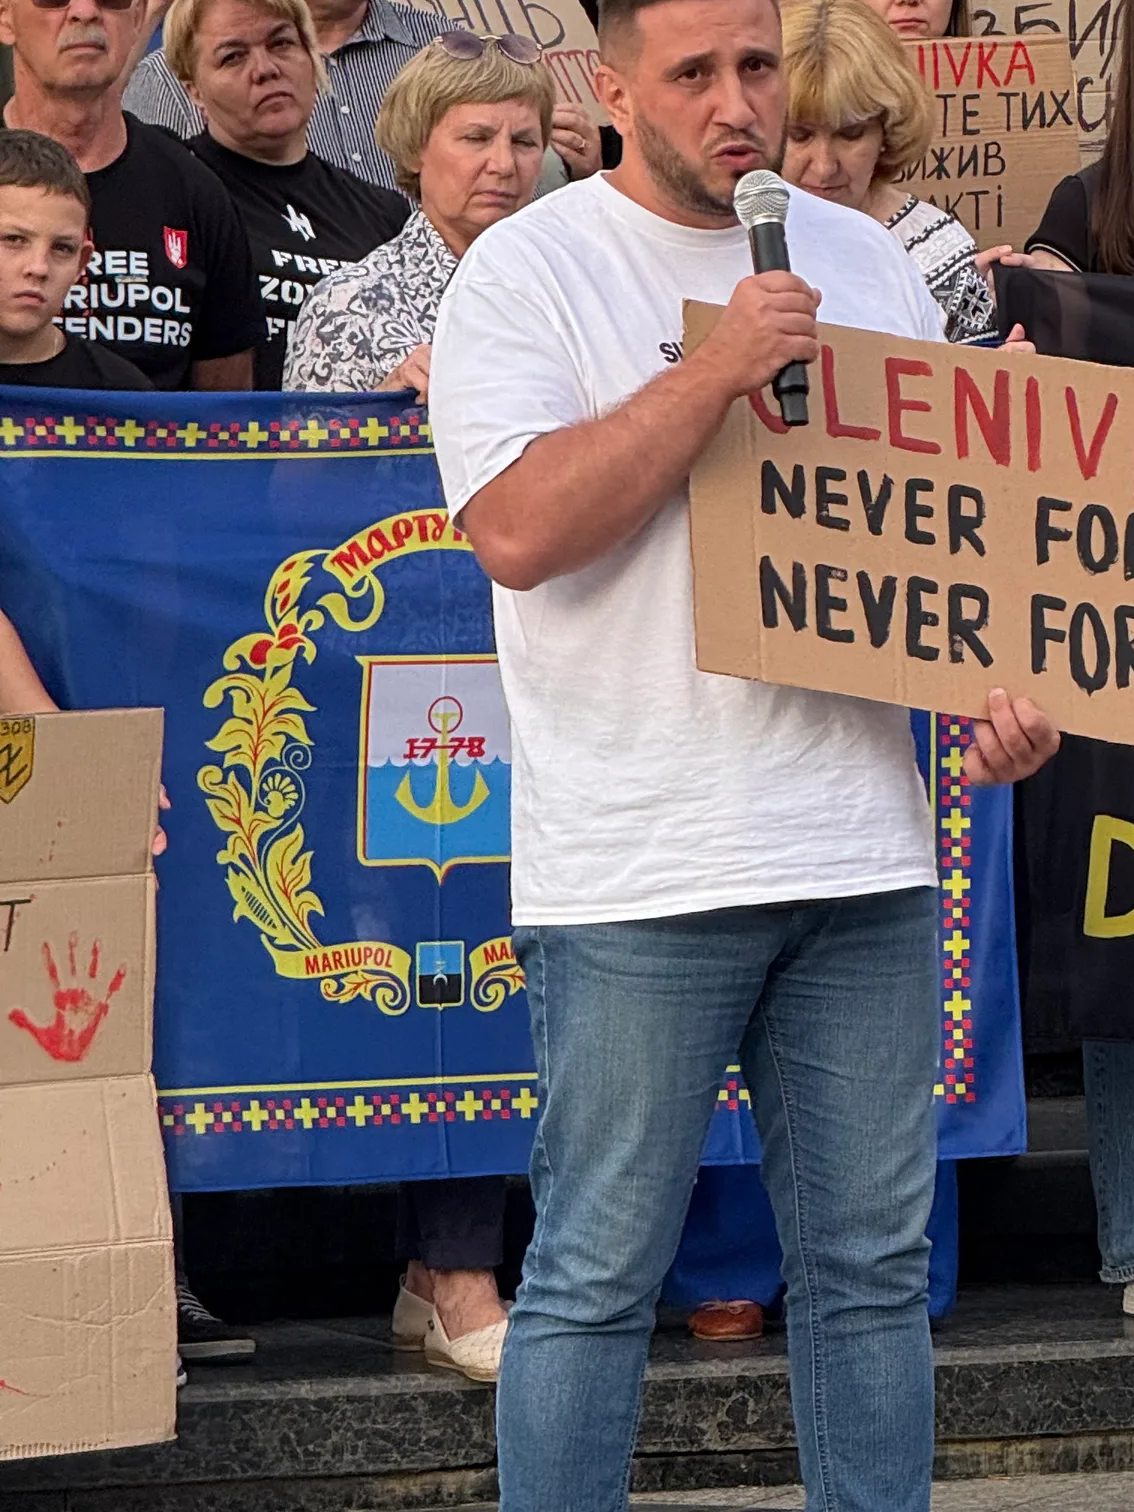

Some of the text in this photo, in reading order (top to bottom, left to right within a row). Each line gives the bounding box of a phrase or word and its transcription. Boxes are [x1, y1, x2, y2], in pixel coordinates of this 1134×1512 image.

[918, 40, 1036, 90] IVKA
[997, 90, 1073, 131] ТИХ
[86, 250, 150, 276] REE
[64, 283, 191, 314] RIUPOL
[52, 316, 193, 348] ENDERS
[760, 458, 986, 557] NEVER
[759, 554, 994, 669] NEVER
[304, 946, 393, 976] MARIUPOL
